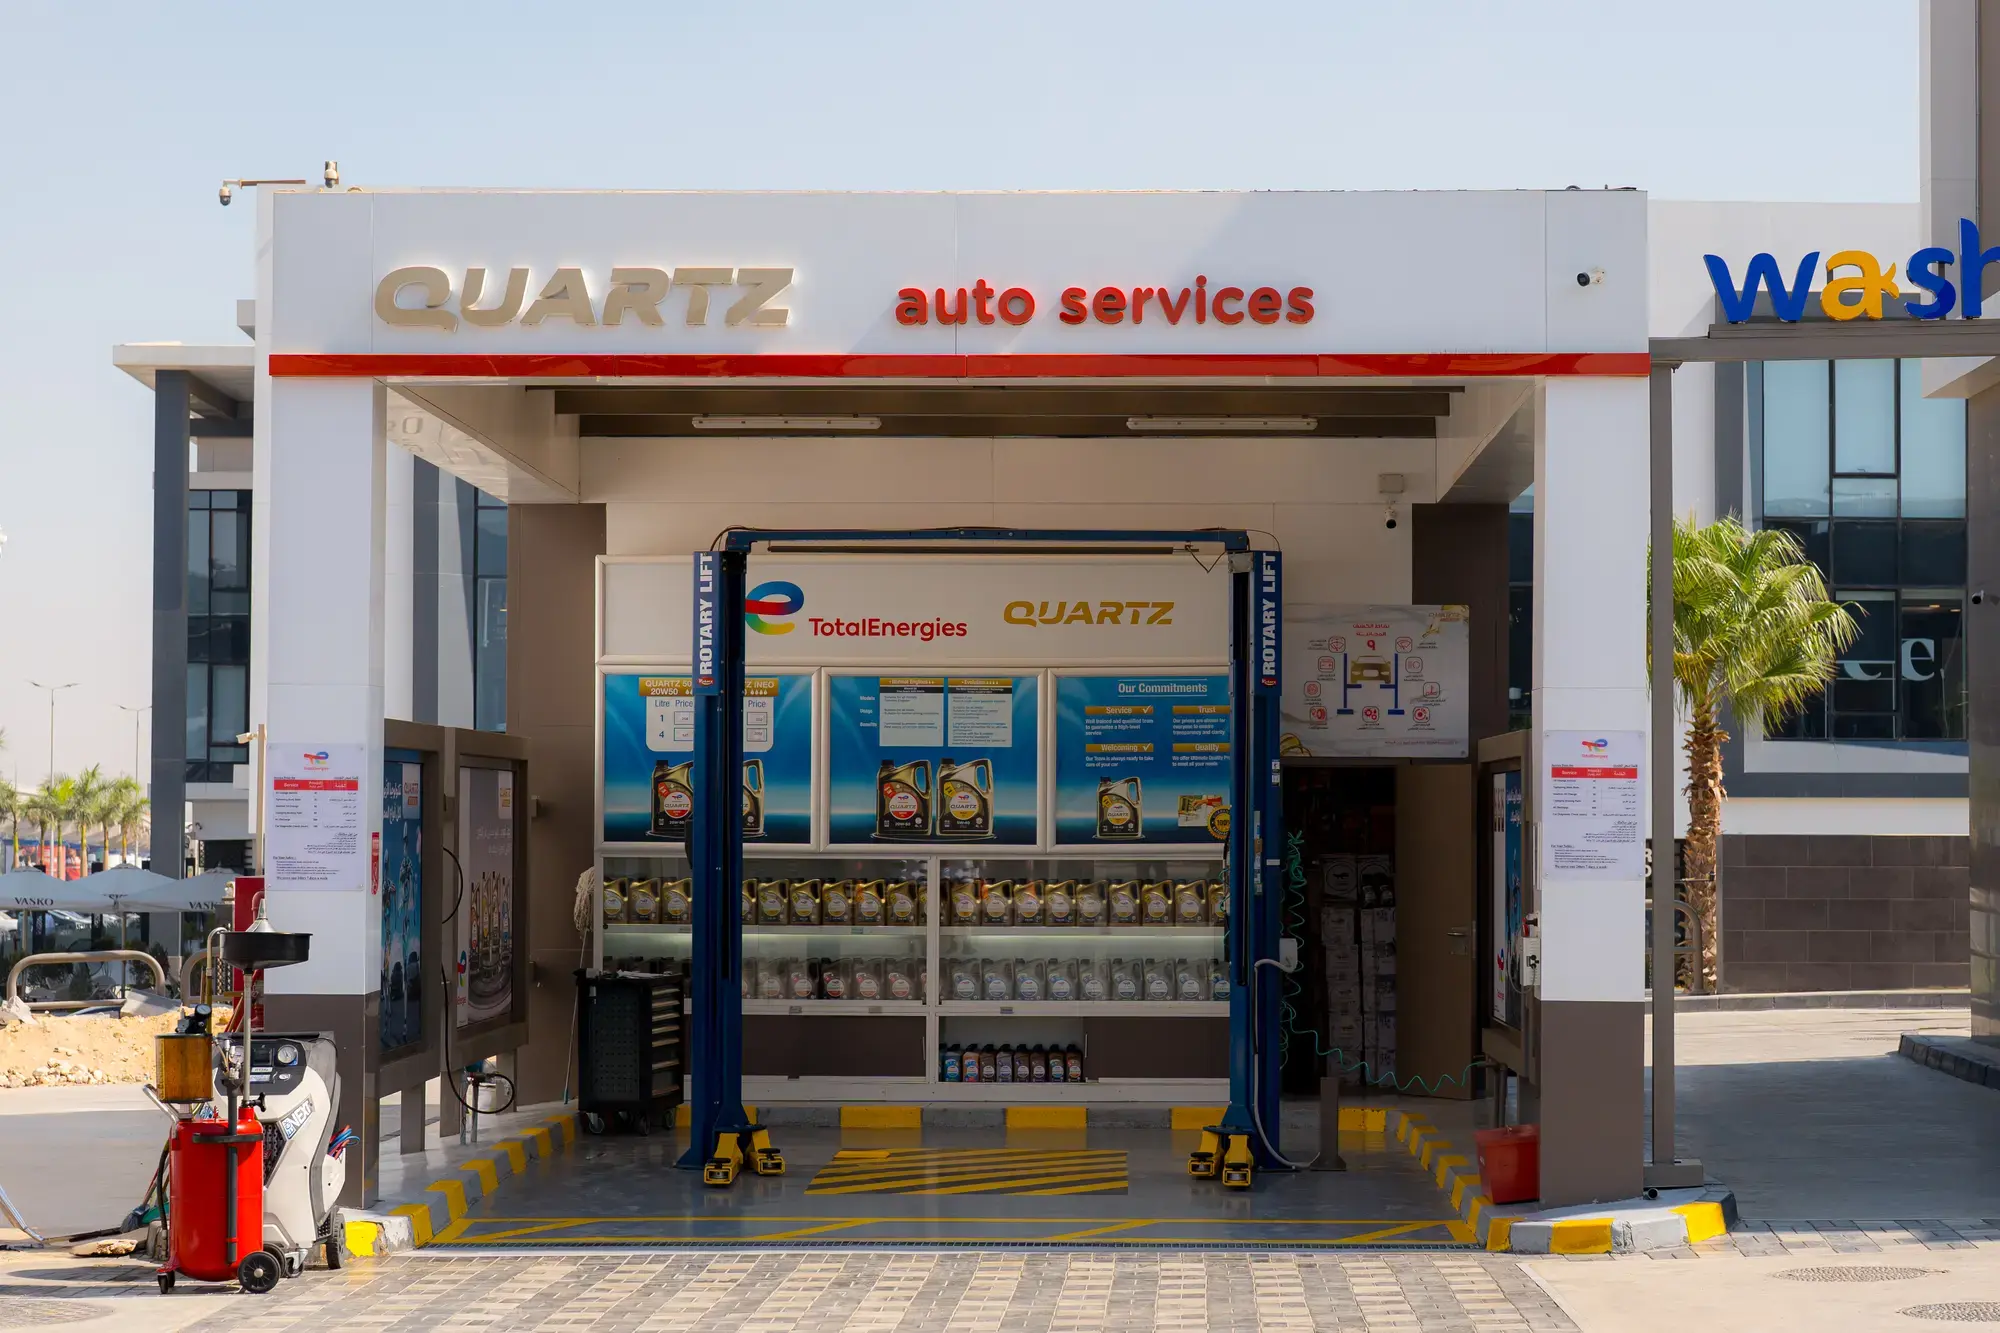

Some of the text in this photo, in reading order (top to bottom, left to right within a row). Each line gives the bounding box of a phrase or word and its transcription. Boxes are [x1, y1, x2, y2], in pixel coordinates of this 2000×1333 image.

[374, 266, 795, 333] QUARTZ
[895, 274, 1315, 325] auto services
[699, 553, 713, 675] ROTARY LIFT
[1002, 600, 1175, 628] QUARTZ
[1262, 553, 1276, 675] ROTARY LIFT
[808, 617, 968, 642] TotalEnergies
[645, 679, 681, 688] QUARTZ
[753, 680, 775, 688] INEO
[1118, 682, 1208, 694] Our Commitments
[654, 699, 670, 708] Litre
[675, 699, 693, 708] Price
[747, 699, 766, 708] Price
[1106, 706, 1132, 714] Service
[1198, 706, 1216, 714] Trust
[659, 714, 664, 722] 1
[1101, 743, 1138, 752] Welcoming
[1194, 743, 1220, 752] Quality
[14, 896, 54, 907] VASKO
[188, 900, 217, 910] VASK
[287, 1098, 313, 1127] NEXT
